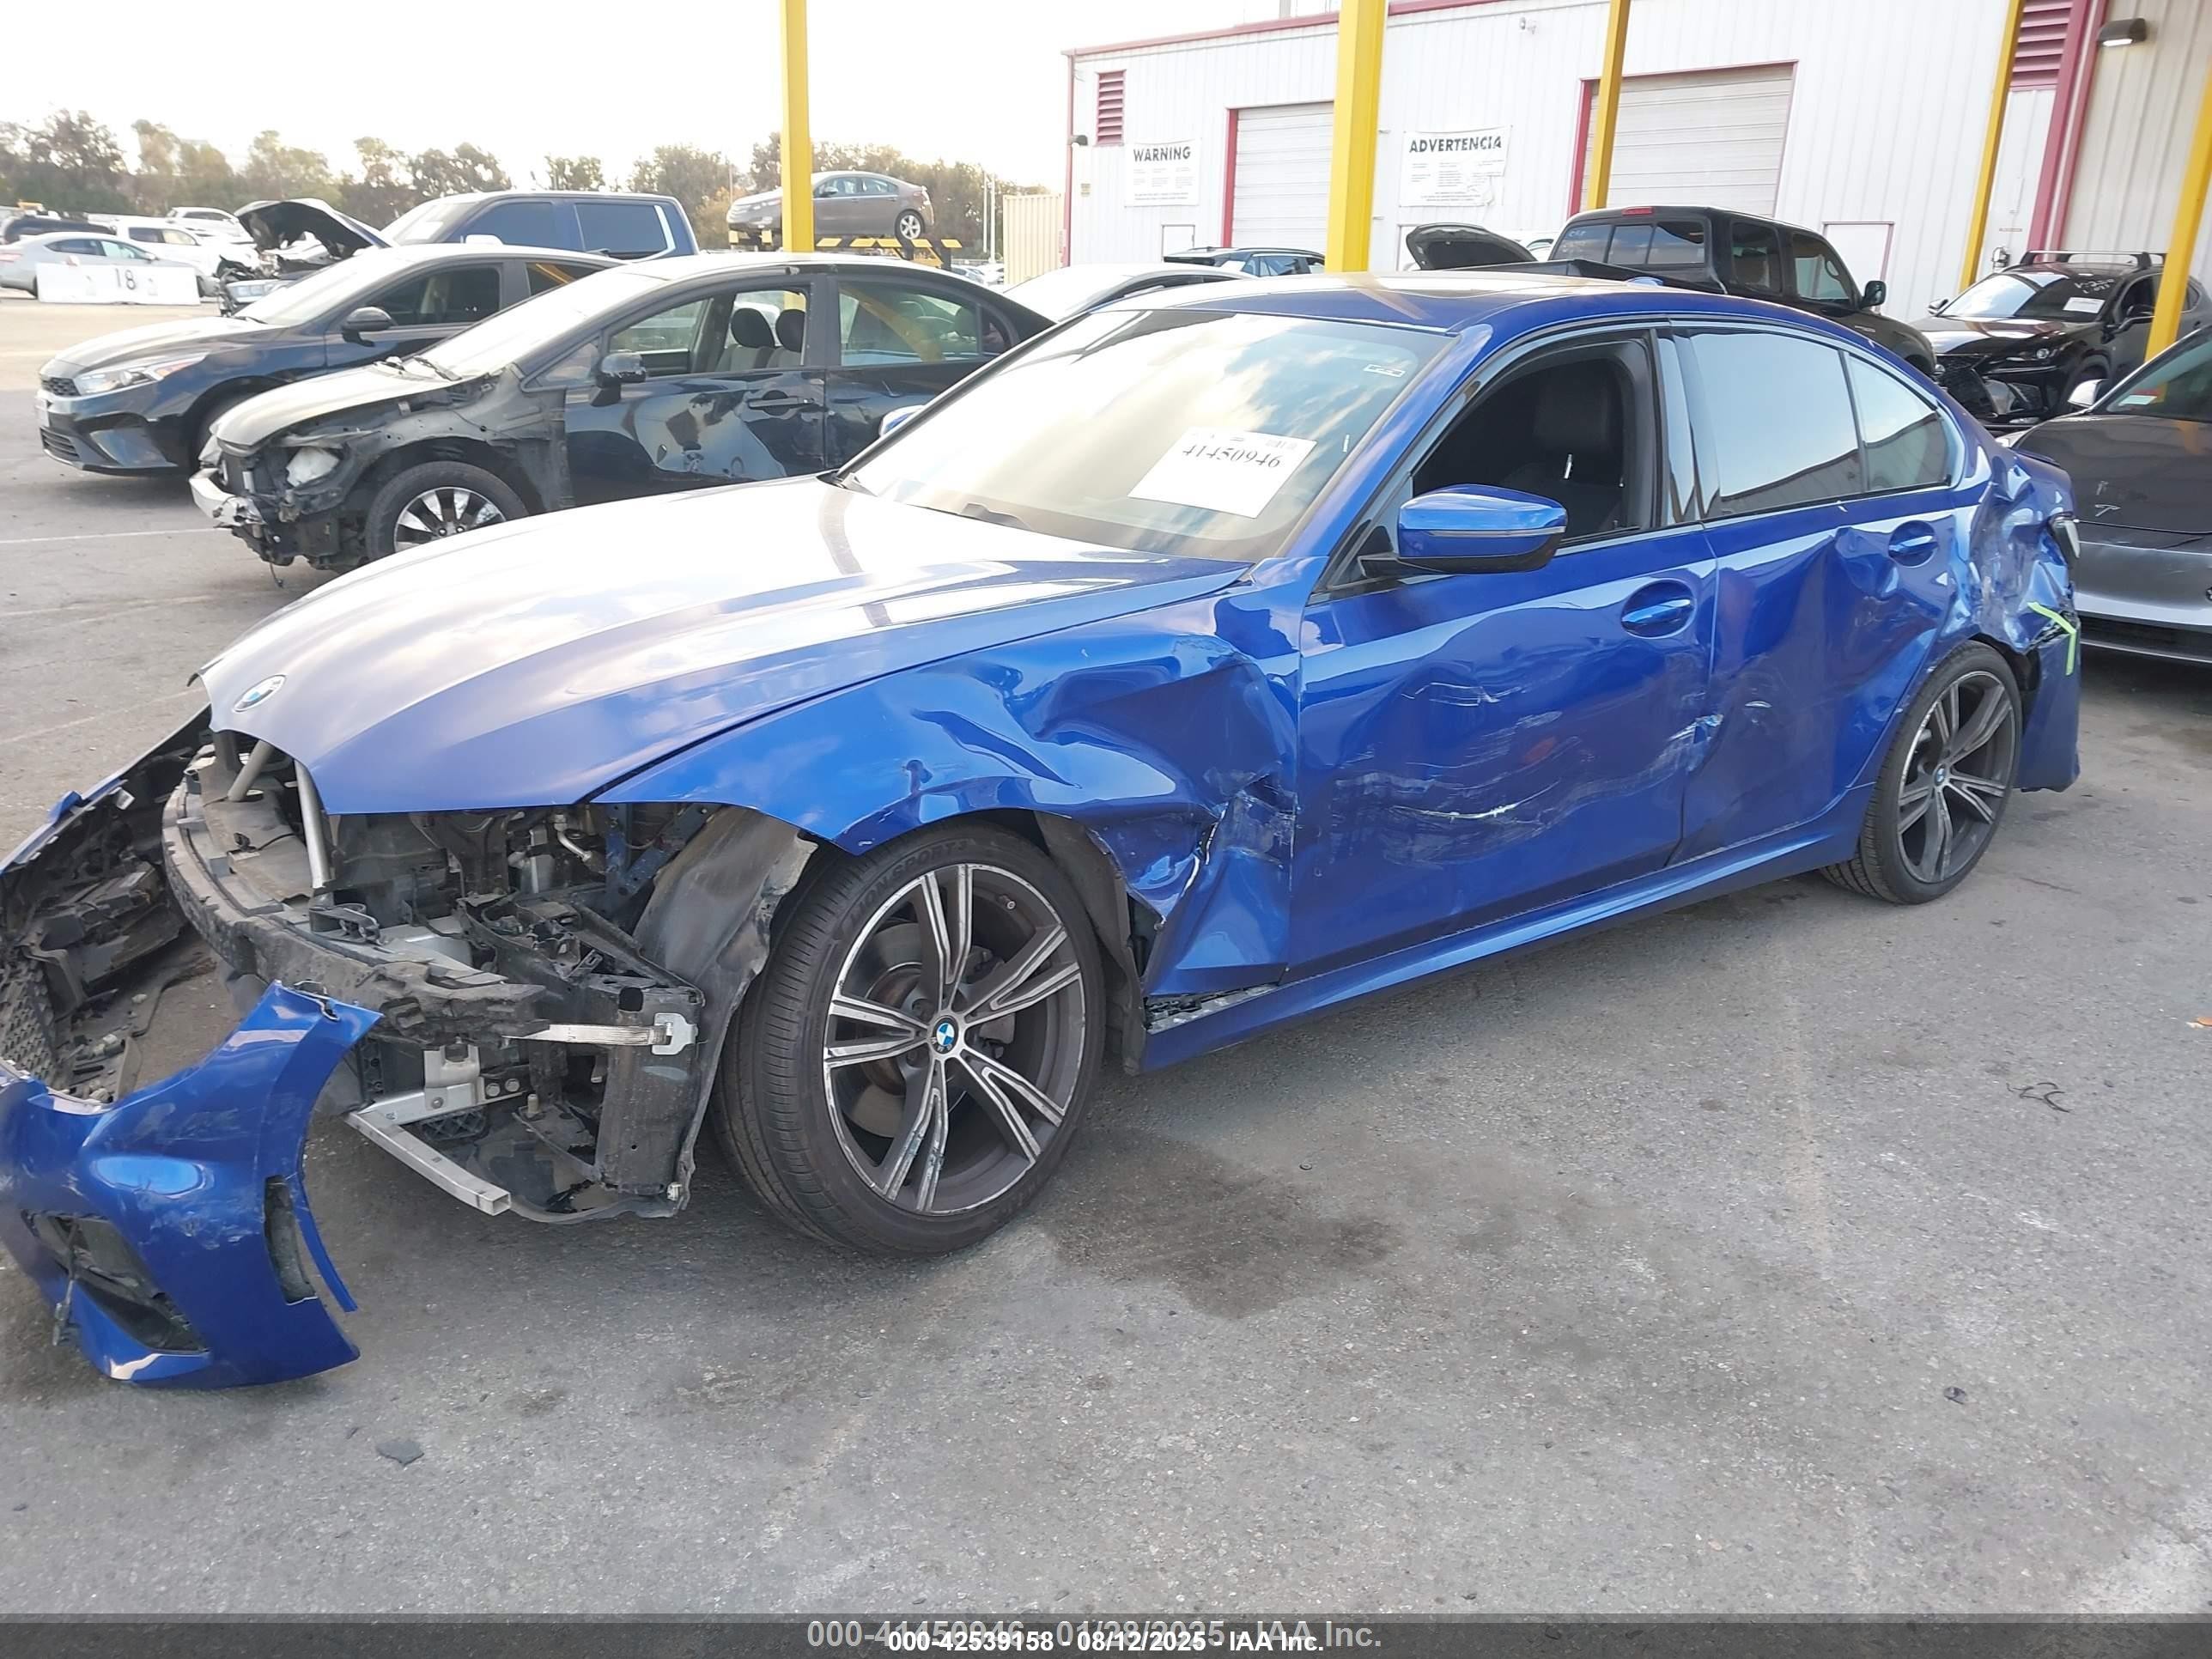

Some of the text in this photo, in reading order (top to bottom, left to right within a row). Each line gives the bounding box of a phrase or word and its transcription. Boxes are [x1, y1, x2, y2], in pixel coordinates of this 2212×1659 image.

[1133, 146, 1191, 162] WARNING
[1409, 136, 1502, 153] ADVERTENCIA
[114, 267, 137, 290] 18
[1182, 443, 1283, 468] 41450946
